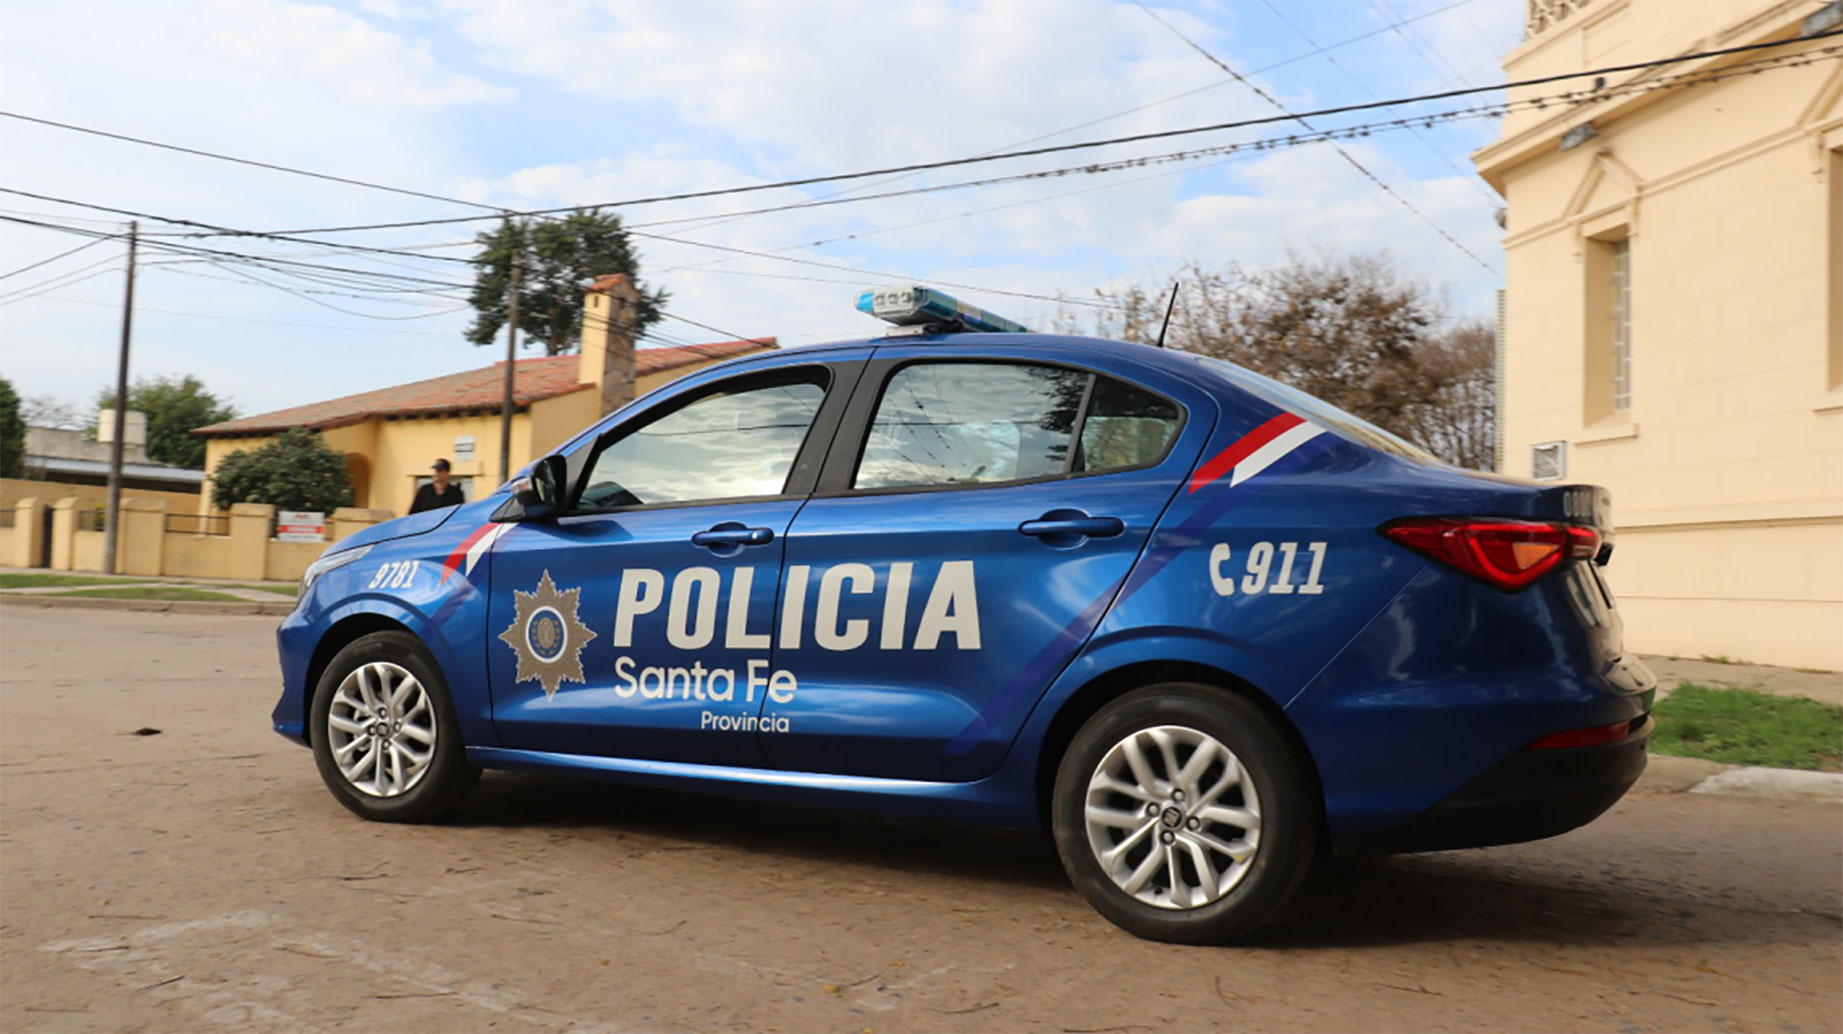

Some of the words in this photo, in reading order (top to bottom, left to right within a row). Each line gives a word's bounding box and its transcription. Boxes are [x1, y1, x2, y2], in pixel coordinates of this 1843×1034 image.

[368, 560, 420, 589] 9781
[1241, 541, 1328, 595] 911
[613, 560, 982, 651] POLICIA
[614, 656, 735, 700] Santa
[746, 659, 798, 703] Fe
[701, 711, 790, 733] Provincia
